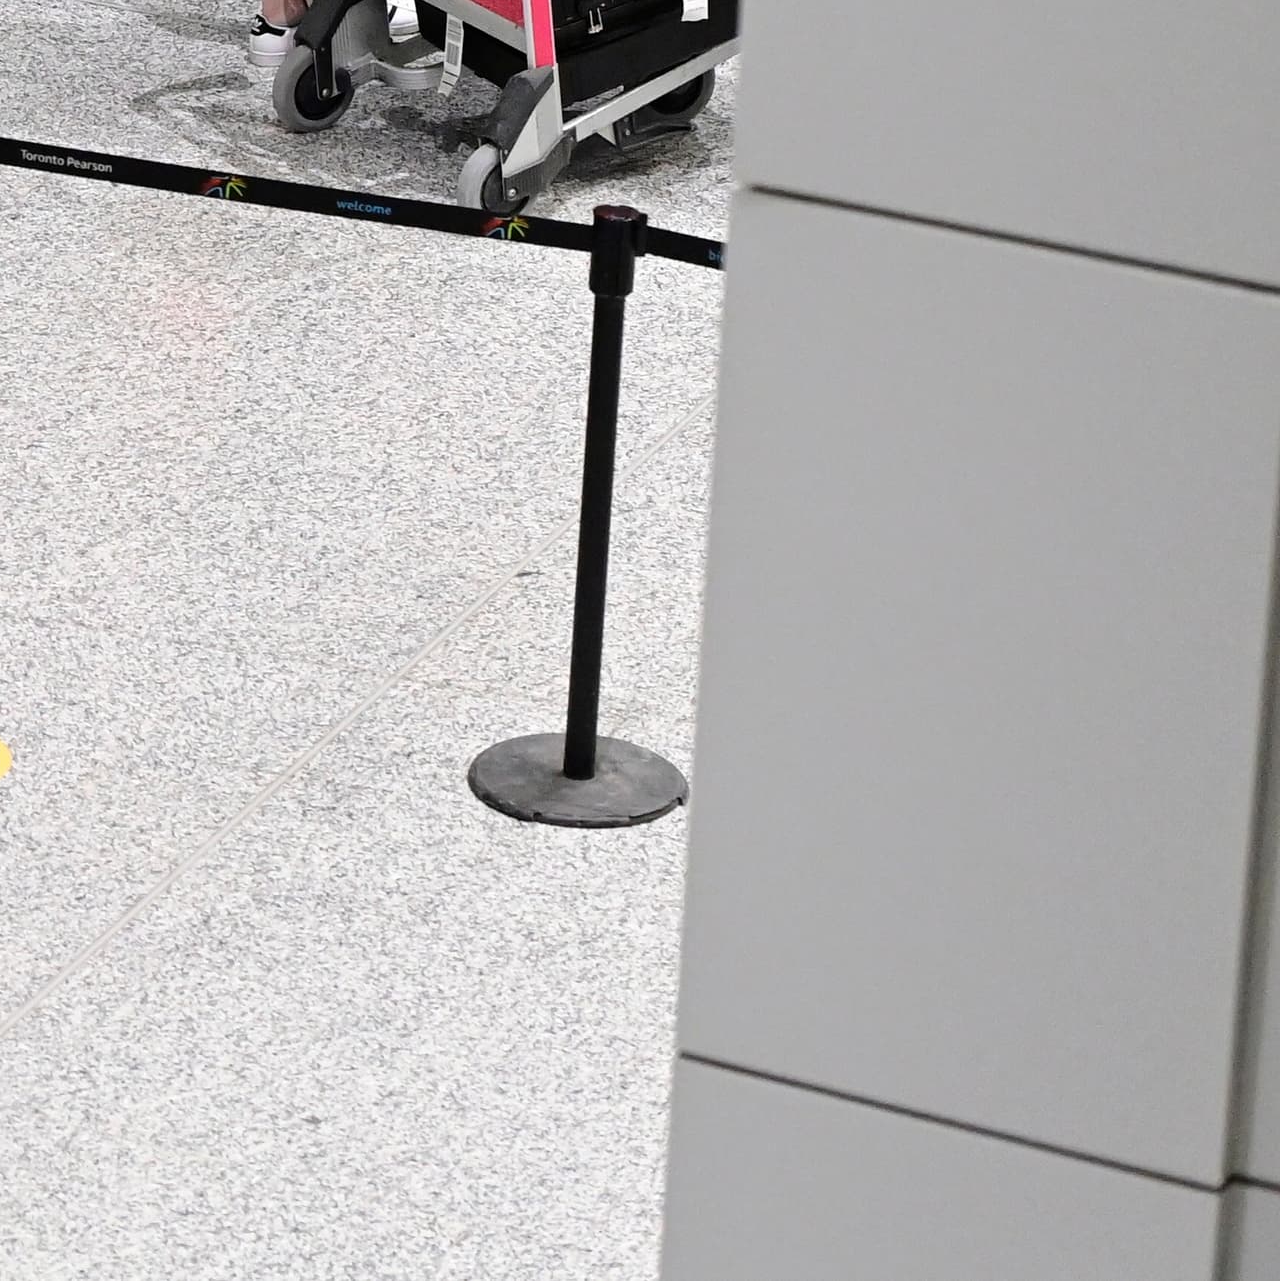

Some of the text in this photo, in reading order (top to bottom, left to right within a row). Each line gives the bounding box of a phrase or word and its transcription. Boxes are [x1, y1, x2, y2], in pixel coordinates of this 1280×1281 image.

[21, 149, 113, 173] Toronto Pearson
[336, 200, 392, 216] welcome
